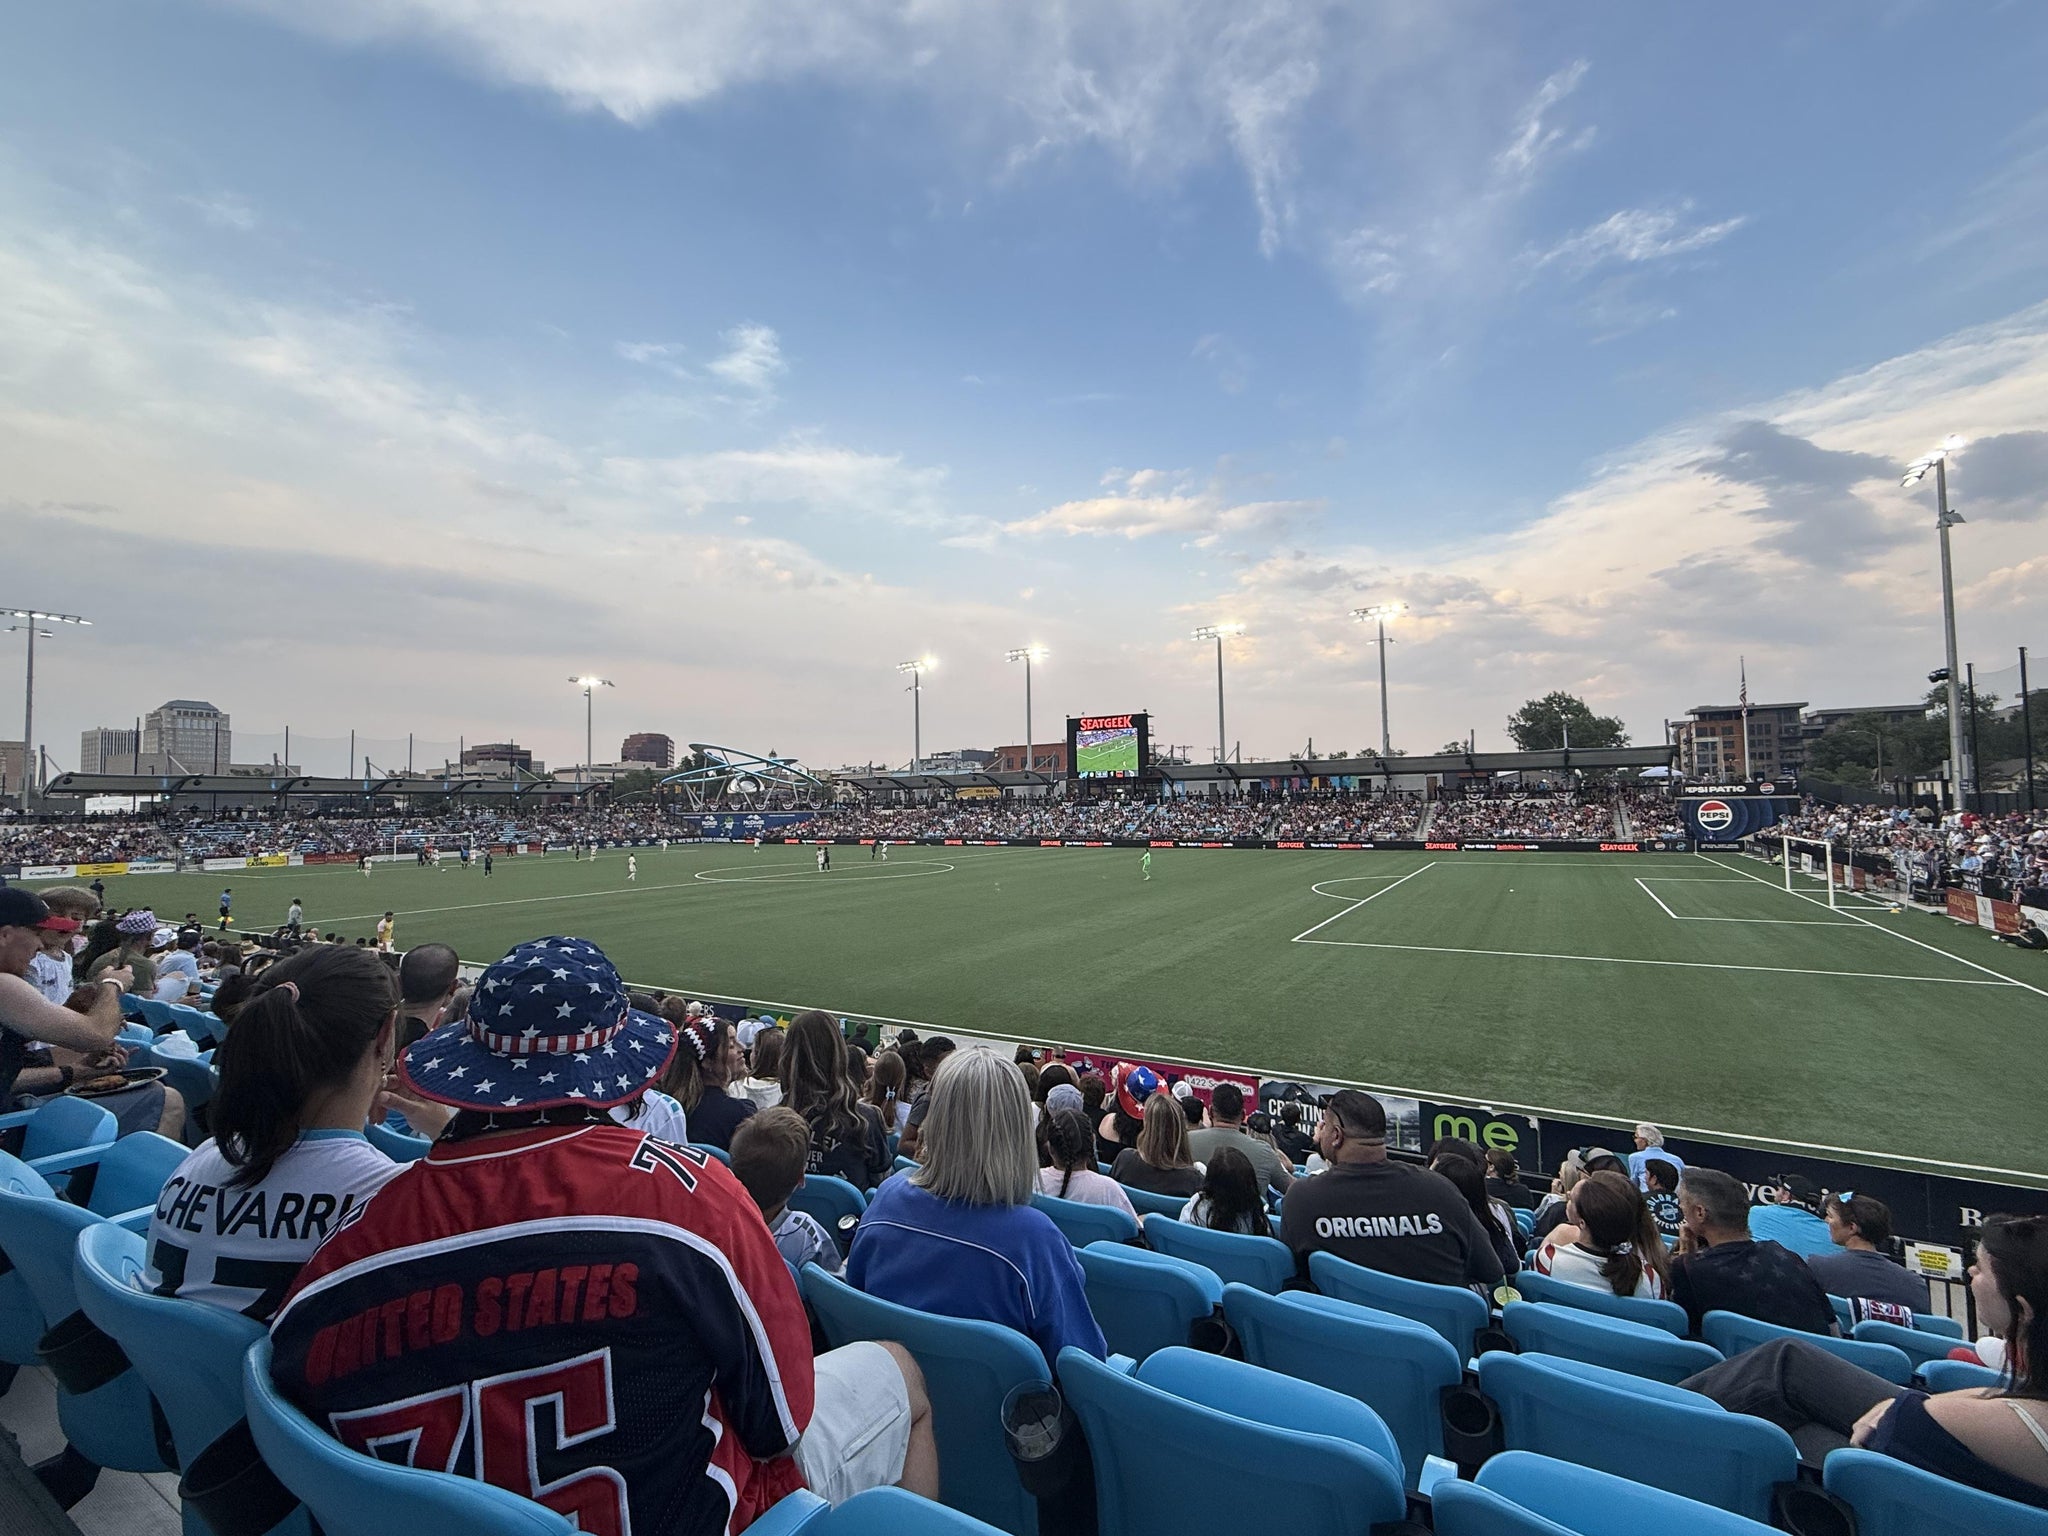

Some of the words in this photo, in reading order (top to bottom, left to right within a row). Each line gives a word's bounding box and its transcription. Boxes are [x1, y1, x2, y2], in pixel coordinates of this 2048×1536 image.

[1080, 715, 1133, 730] SEATGEEK
[1709, 785, 1747, 793] PATIO
[1600, 843, 1638, 851] SEATGEEK
[1185, 1075, 1207, 1087] 1422
[1434, 1113, 1519, 1151] me
[156, 1176, 355, 1240] CHEVARRI
[1315, 1212, 1443, 1238] ORIGINALS
[305, 1283, 463, 1386] UNITED
[474, 1262, 640, 1337] STATES
